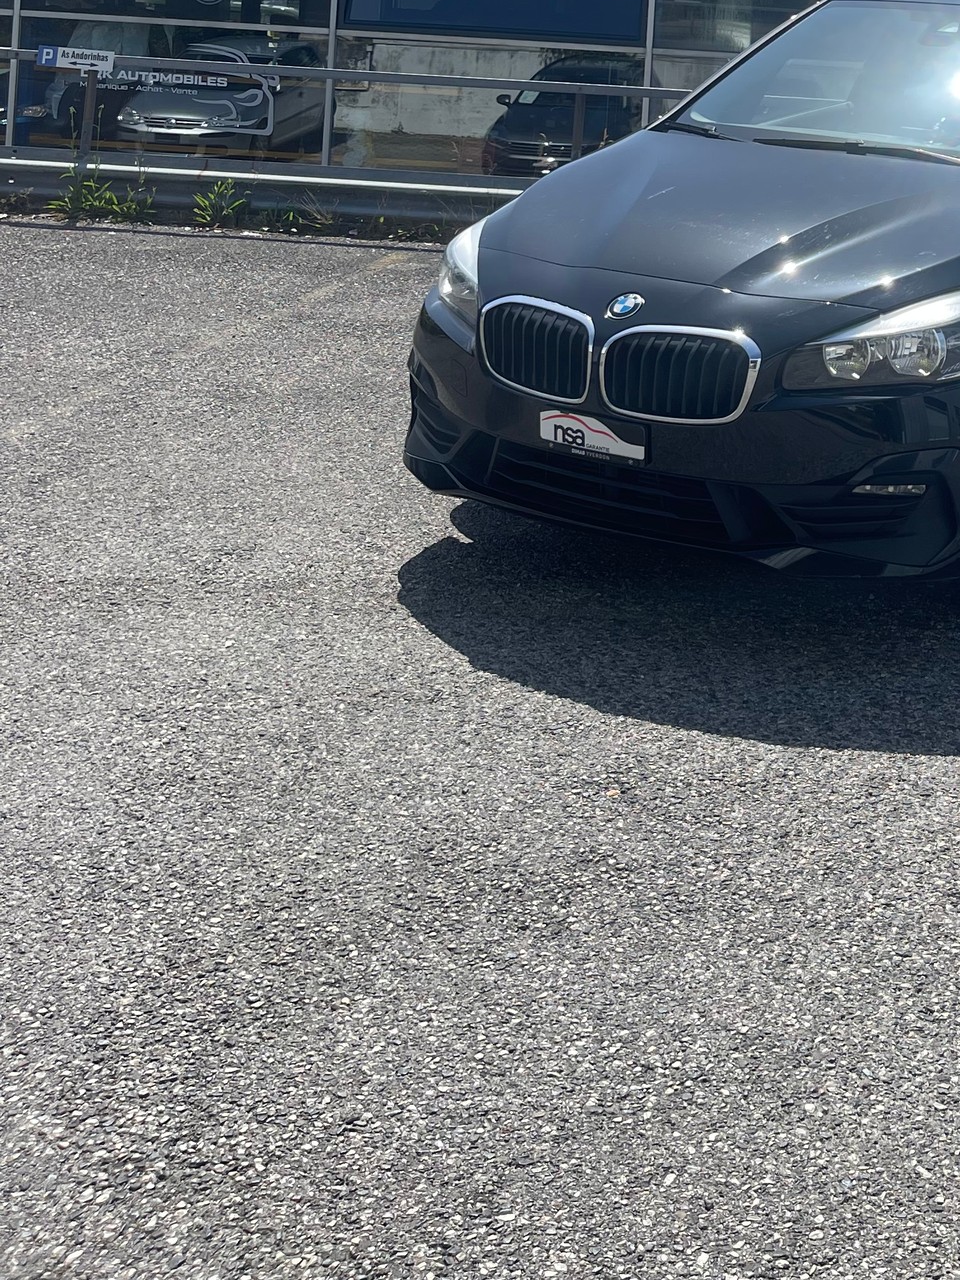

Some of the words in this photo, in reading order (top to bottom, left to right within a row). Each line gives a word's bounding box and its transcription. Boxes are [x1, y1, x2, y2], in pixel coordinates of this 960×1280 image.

[61, 50, 70, 59] As
[71, 50, 109, 62] Andorinhas
[117, 70, 228, 87] AUTOMOBILES
[136, 84, 163, 93] Achat
[171, 87, 198, 95] Vente
[554, 424, 585, 447] nsa
[586, 443, 610, 453] GARANTIE
